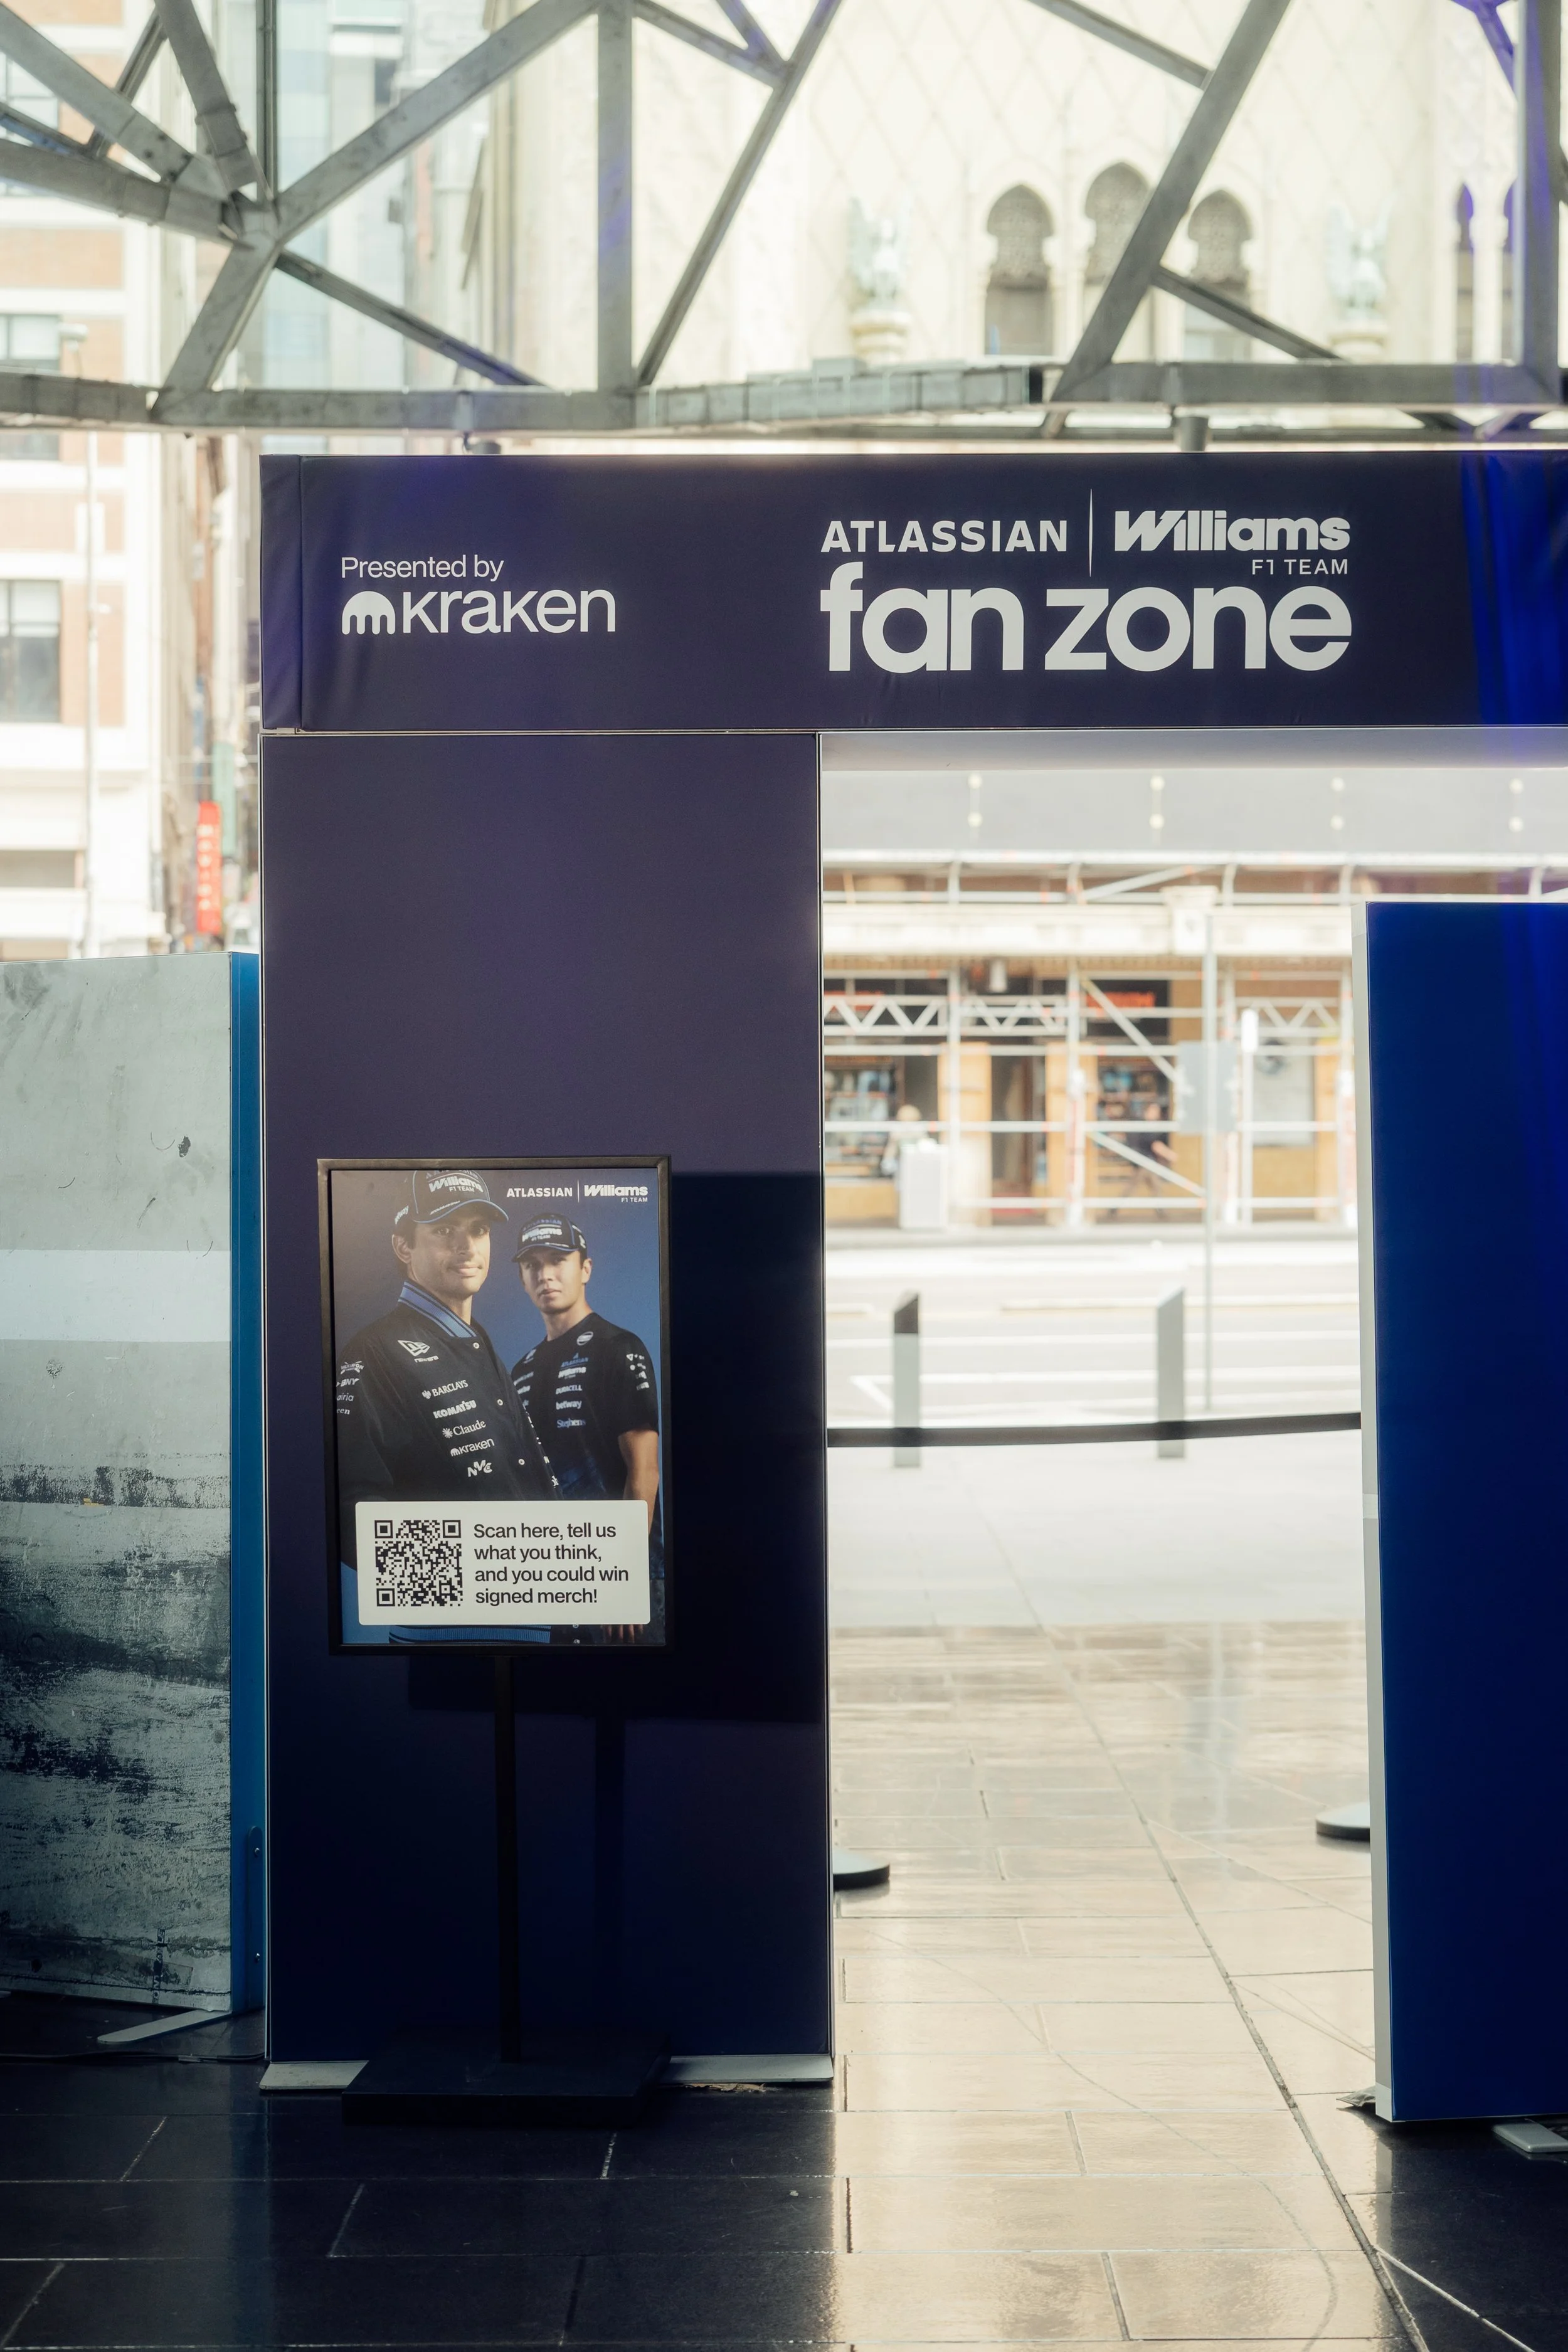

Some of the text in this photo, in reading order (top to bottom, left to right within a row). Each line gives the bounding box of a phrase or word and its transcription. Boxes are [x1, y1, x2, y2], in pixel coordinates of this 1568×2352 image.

[821, 511, 1350, 552] ATLASSIAN Williams
[342, 555, 504, 581] Presented by
[1253, 558, 1348, 575] F1 TEAM
[403, 590, 616, 633] kraken
[820, 562, 1352, 673] fan zone
[428, 1175, 484, 1193] Williams
[507, 1184, 649, 1198] ATLASSIAN Williams
[341, 1378, 359, 1387] BNY
[432, 1380, 469, 1397] BARCLAYS
[433, 1399, 477, 1419] KOMATSU
[453, 1419, 487, 1436] Claude
[459, 1438, 495, 1454] kraken
[474, 1522, 617, 1541] Scan here, tell us
[474, 1544, 602, 1563] what you think,
[475, 1565, 629, 1585] and you could win
[475, 1587, 598, 1607] signed merch!
